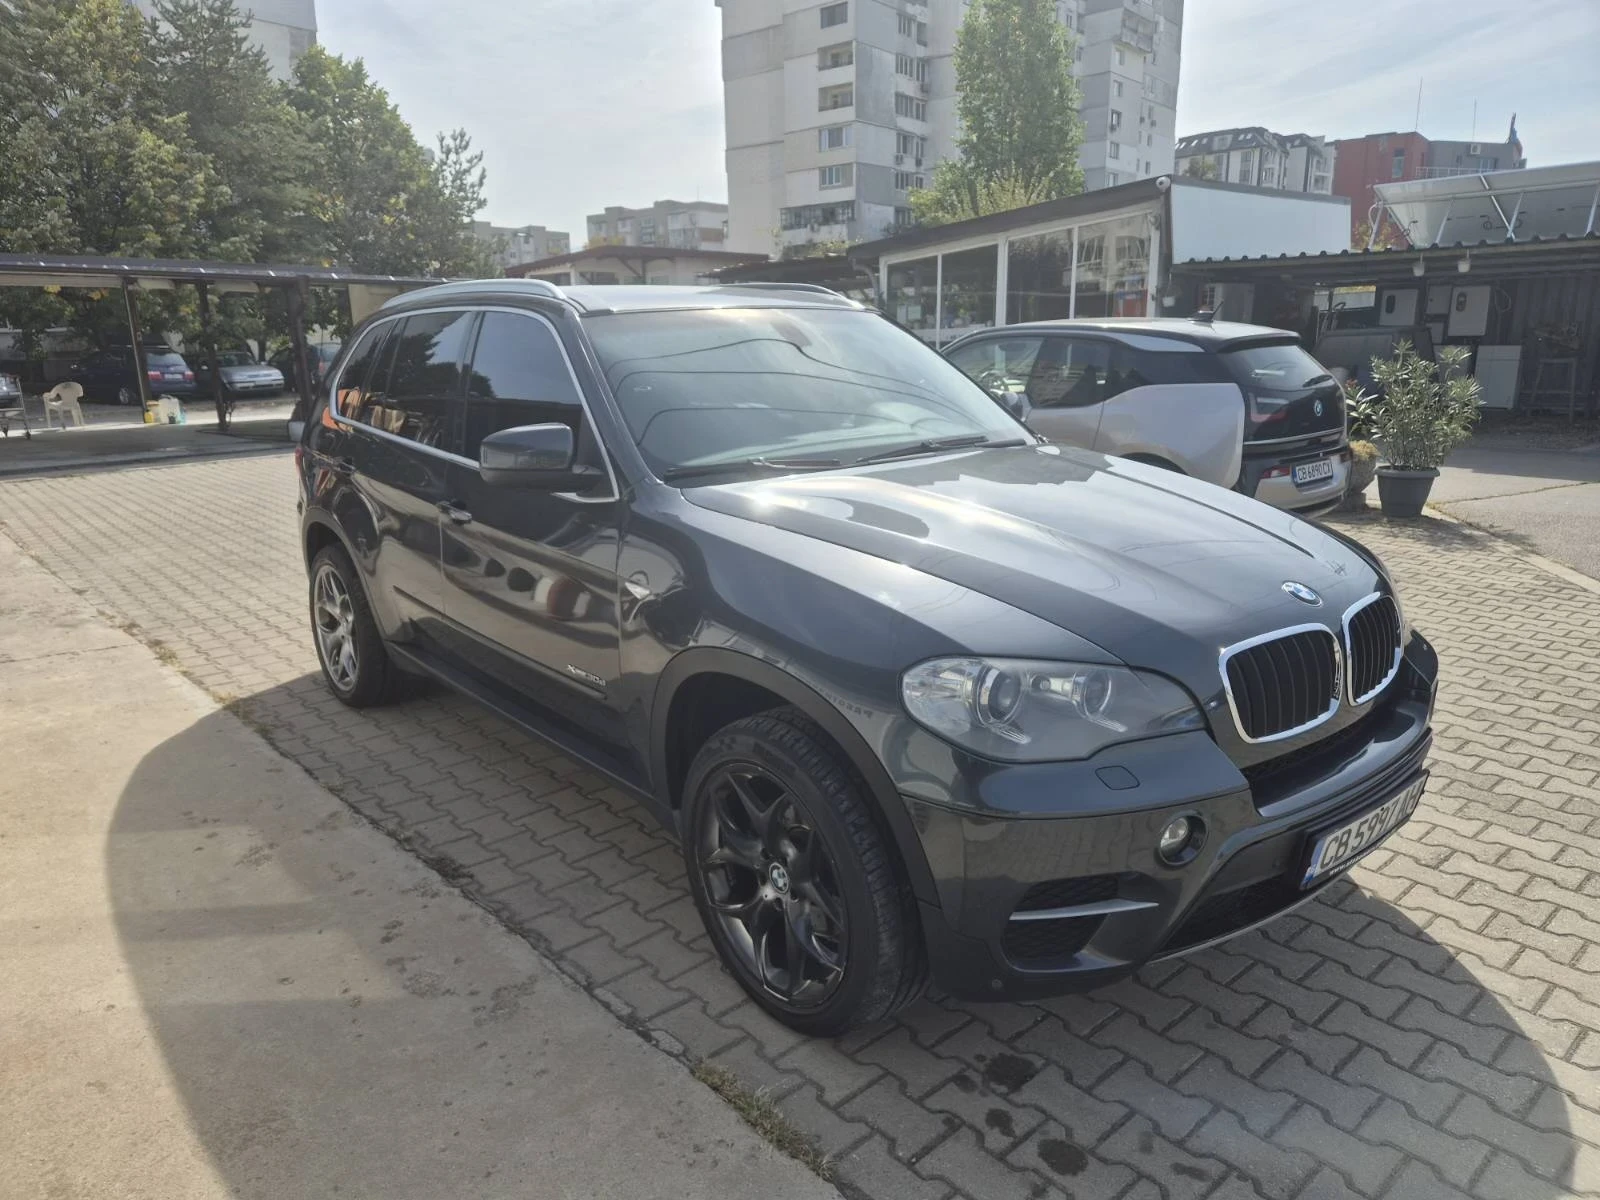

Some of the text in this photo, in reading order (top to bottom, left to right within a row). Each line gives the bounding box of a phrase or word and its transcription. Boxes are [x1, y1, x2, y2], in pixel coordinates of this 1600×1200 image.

[1298, 467, 1307, 480] CB
[1320, 828, 1352, 870] CB
[1350, 797, 1400, 853] 5997
